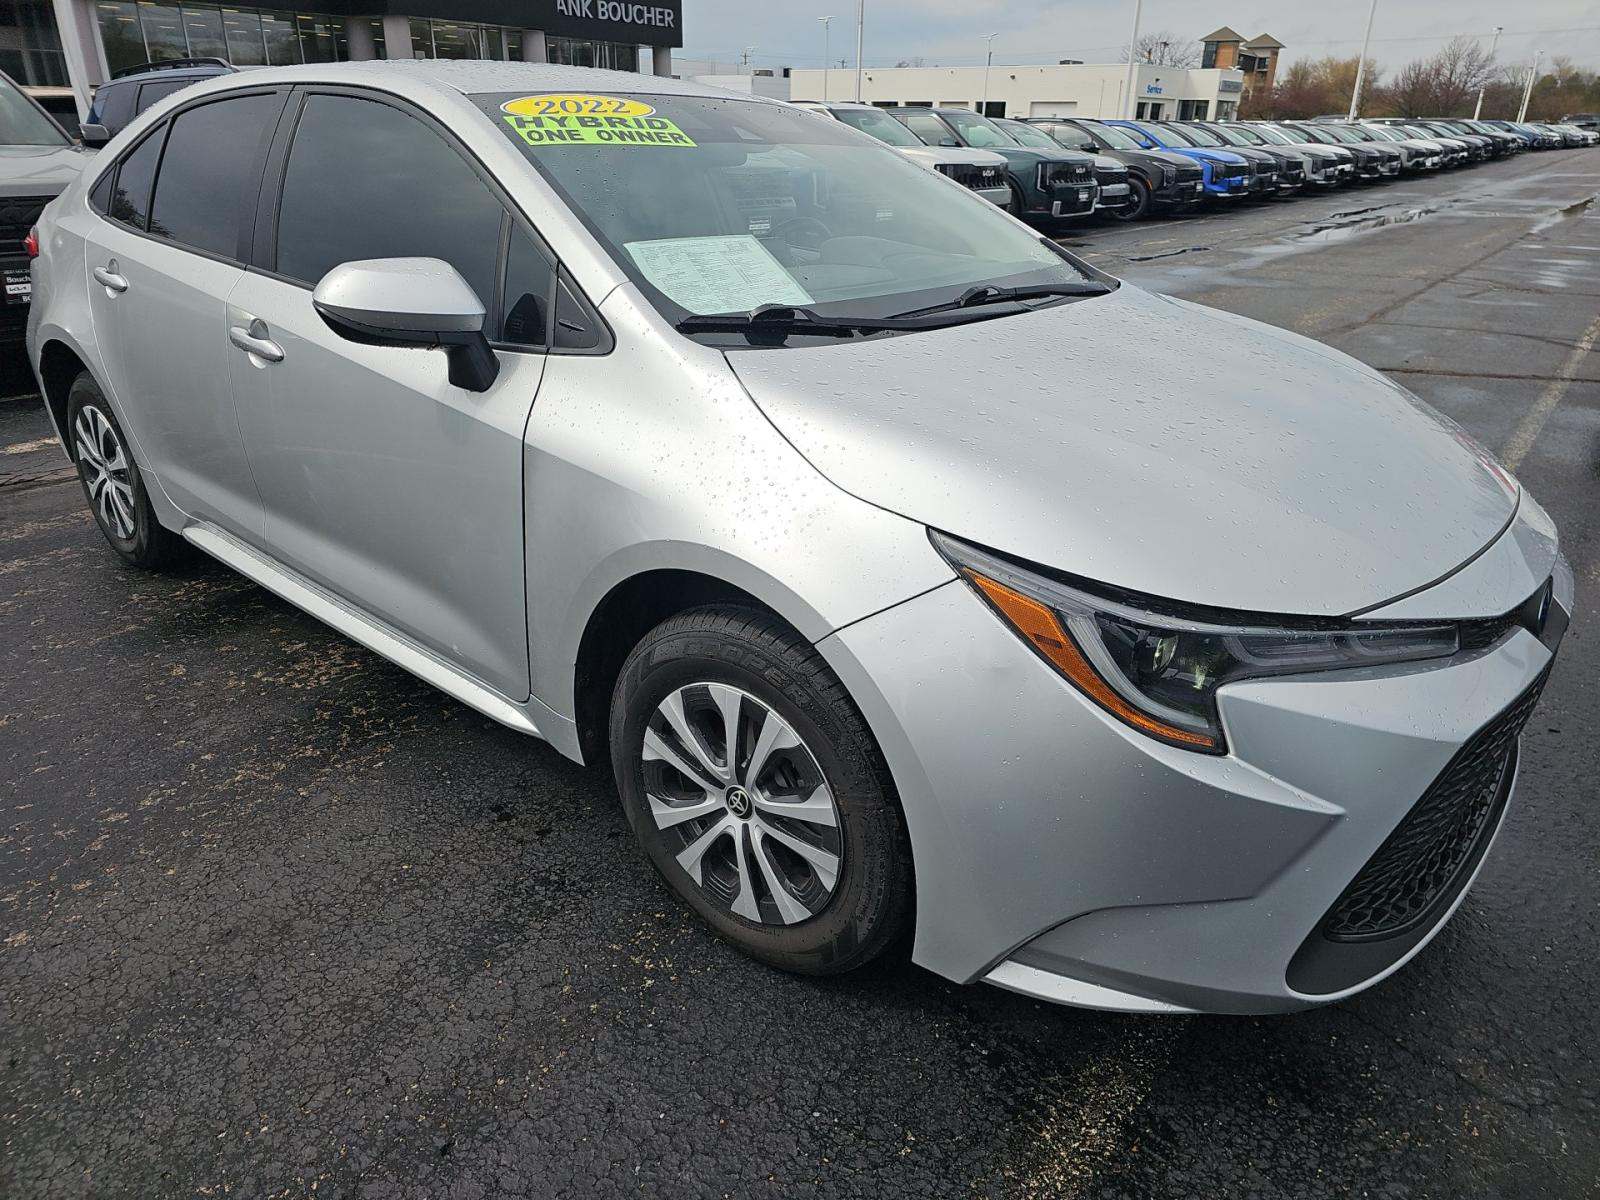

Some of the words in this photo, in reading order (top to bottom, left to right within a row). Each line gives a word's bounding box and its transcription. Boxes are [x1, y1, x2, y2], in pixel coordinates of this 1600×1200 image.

[598, 1, 674, 27] BOUCHER
[534, 99, 631, 115] 2022
[514, 116, 669, 130] HYBRID
[526, 129, 584, 142] ONE
[598, 129, 689, 144] OWNER
